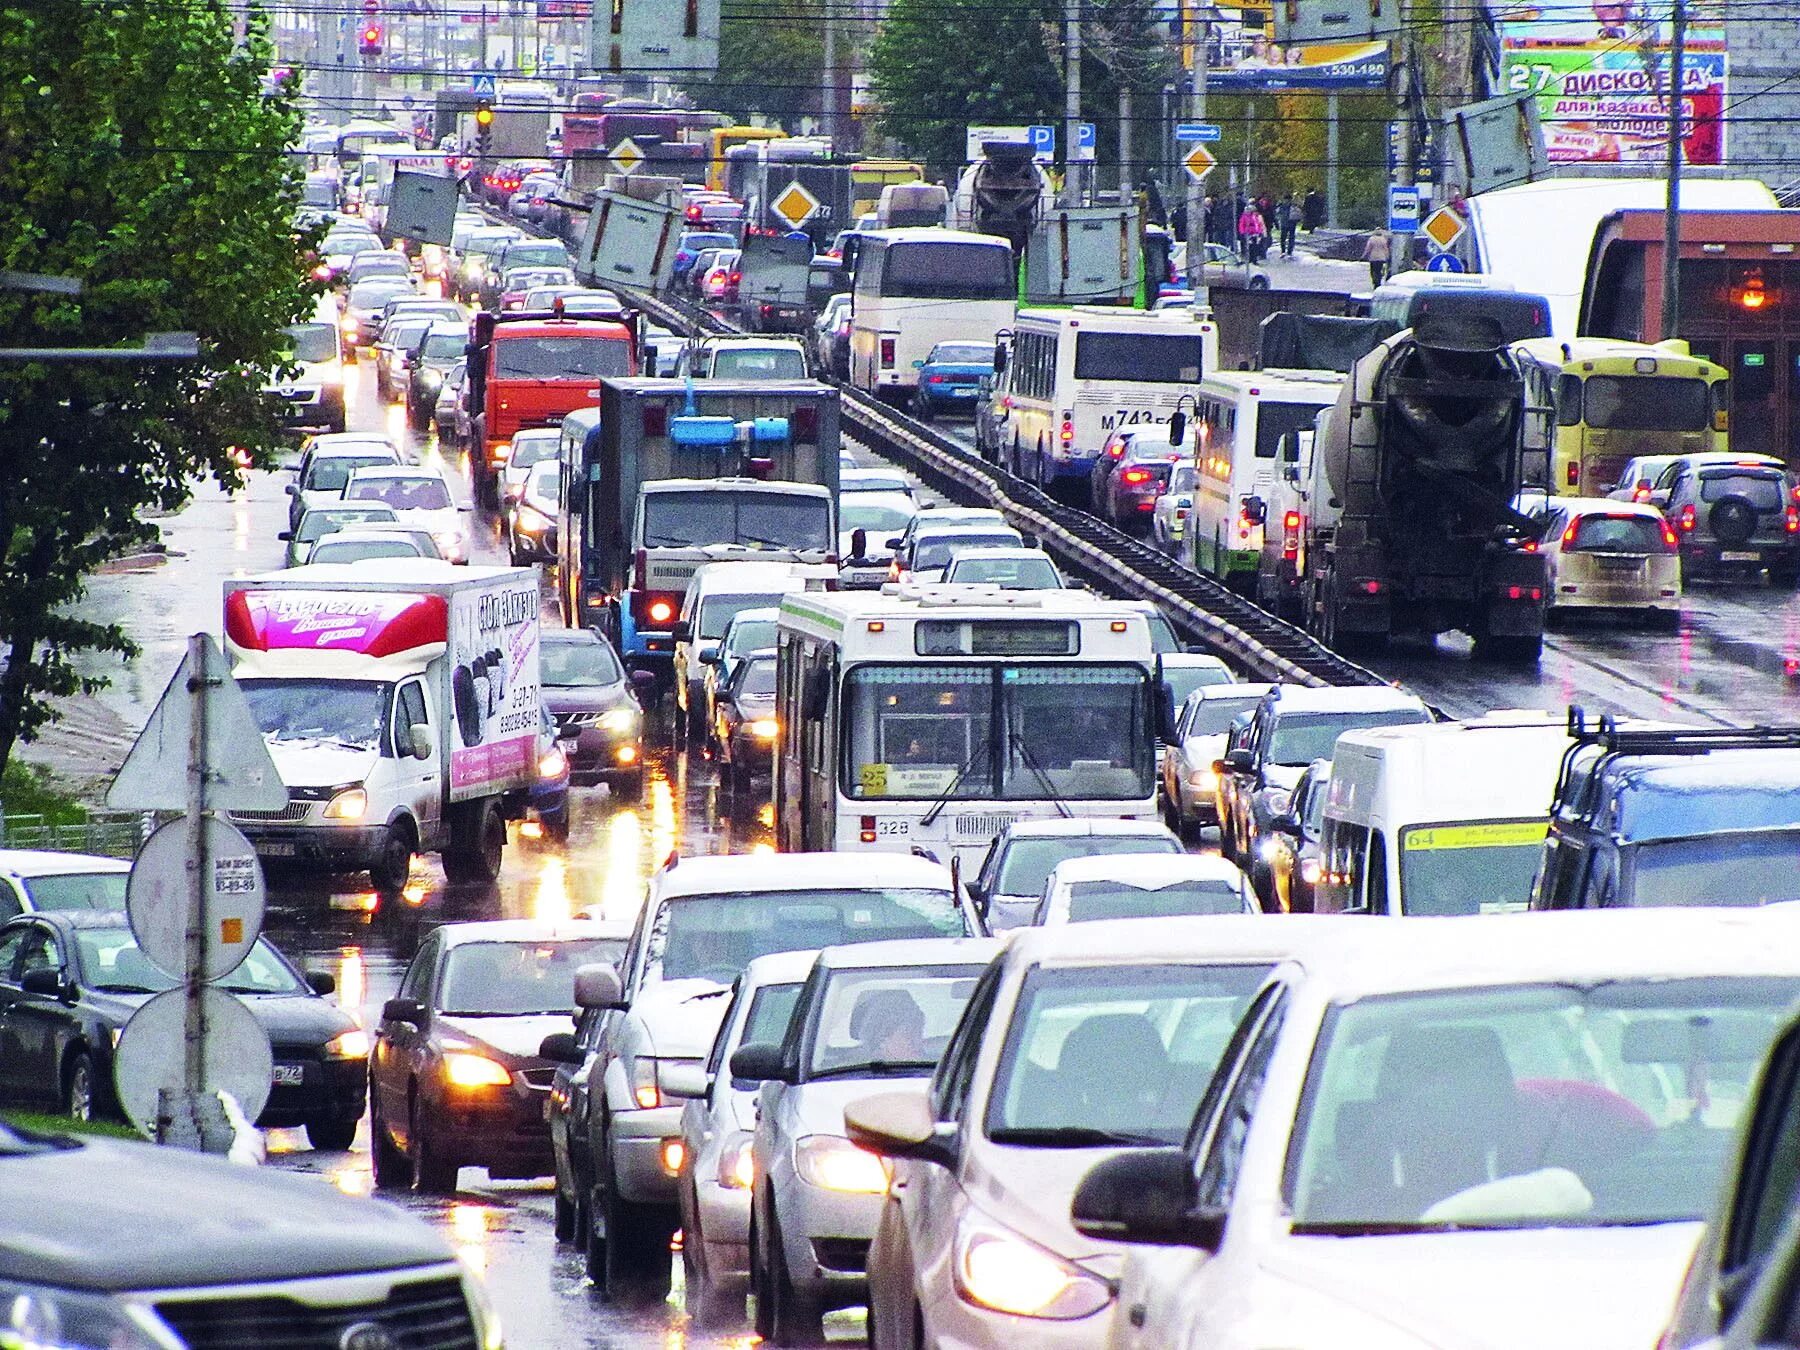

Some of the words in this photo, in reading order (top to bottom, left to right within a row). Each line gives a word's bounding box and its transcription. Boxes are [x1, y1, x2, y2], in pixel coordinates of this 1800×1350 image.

[1331, 64, 1385, 76] 530-180
[1510, 63, 1552, 90] 27
[1555, 101, 1591, 115] для
[1408, 830, 1435, 847] 64
